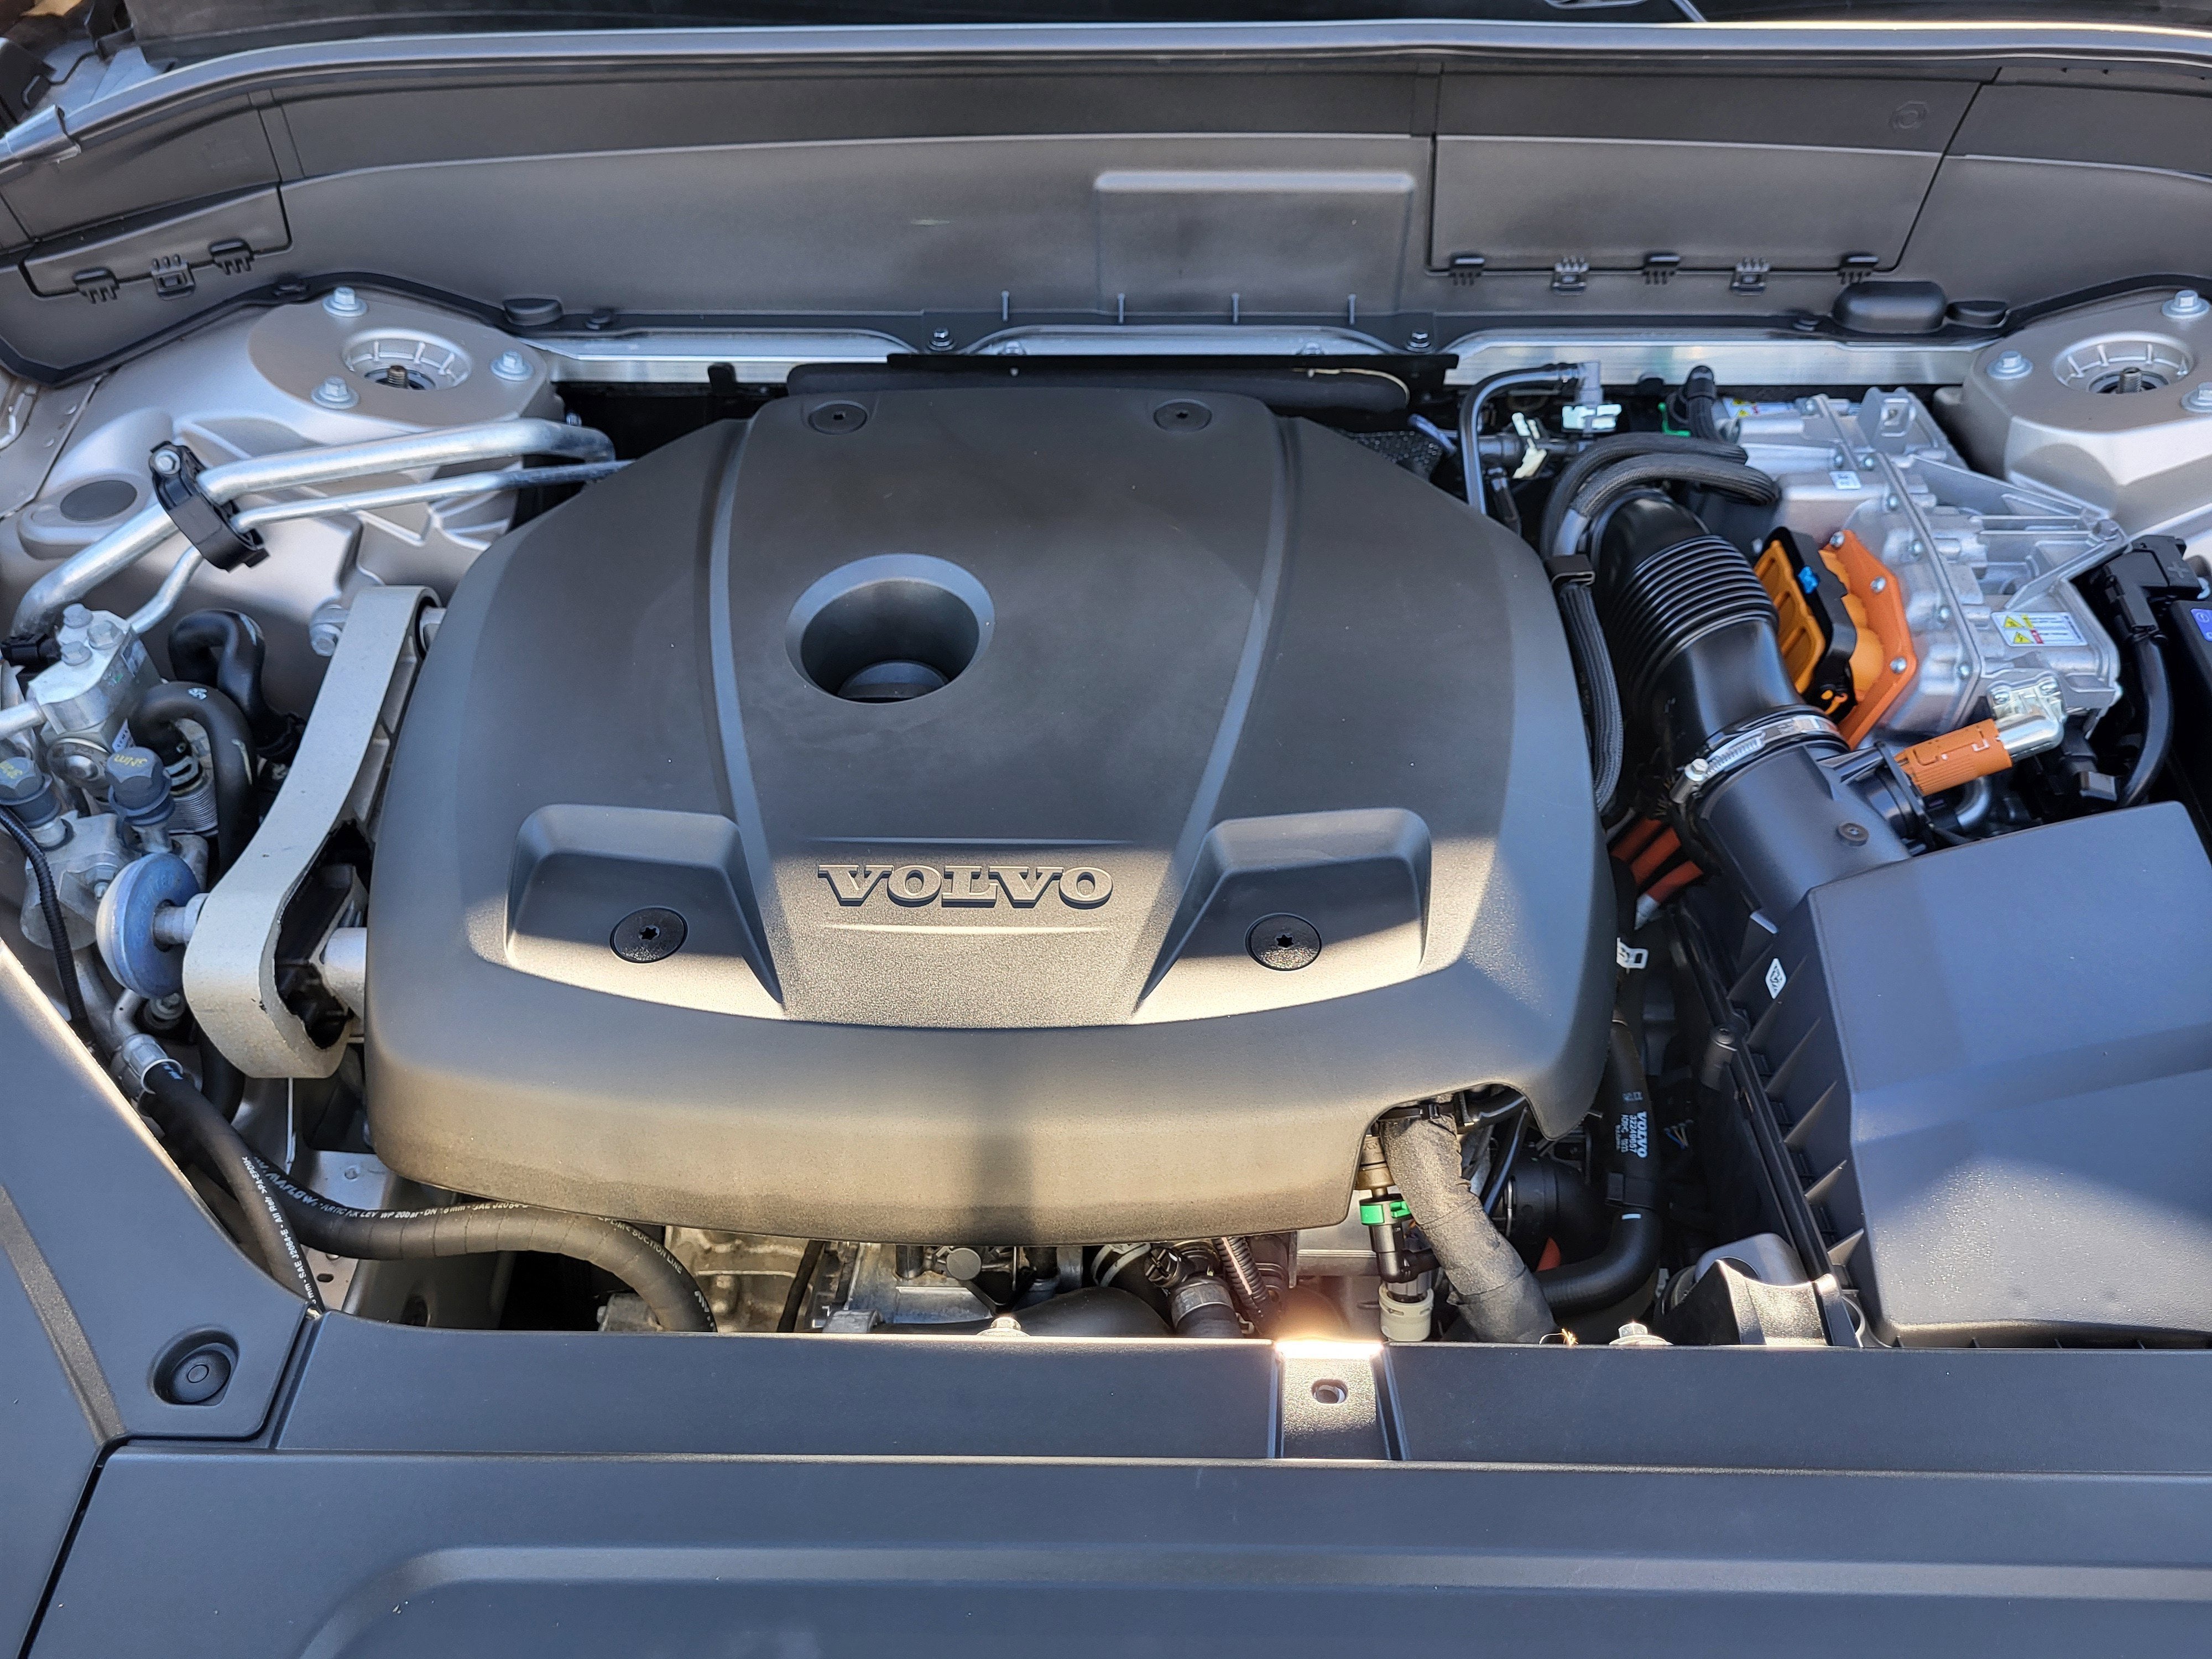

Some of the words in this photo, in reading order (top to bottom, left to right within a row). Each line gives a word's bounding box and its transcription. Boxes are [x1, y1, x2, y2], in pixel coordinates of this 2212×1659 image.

[818, 864, 1113, 910] VOLVO
[1637, 1111, 1647, 1158] VOLVO
[272, 1212, 283, 1223] All
[294, 1260, 306, 1279] SAE
[632, 1229, 667, 1258] SUCTION
[666, 1255, 683, 1274] LINE
